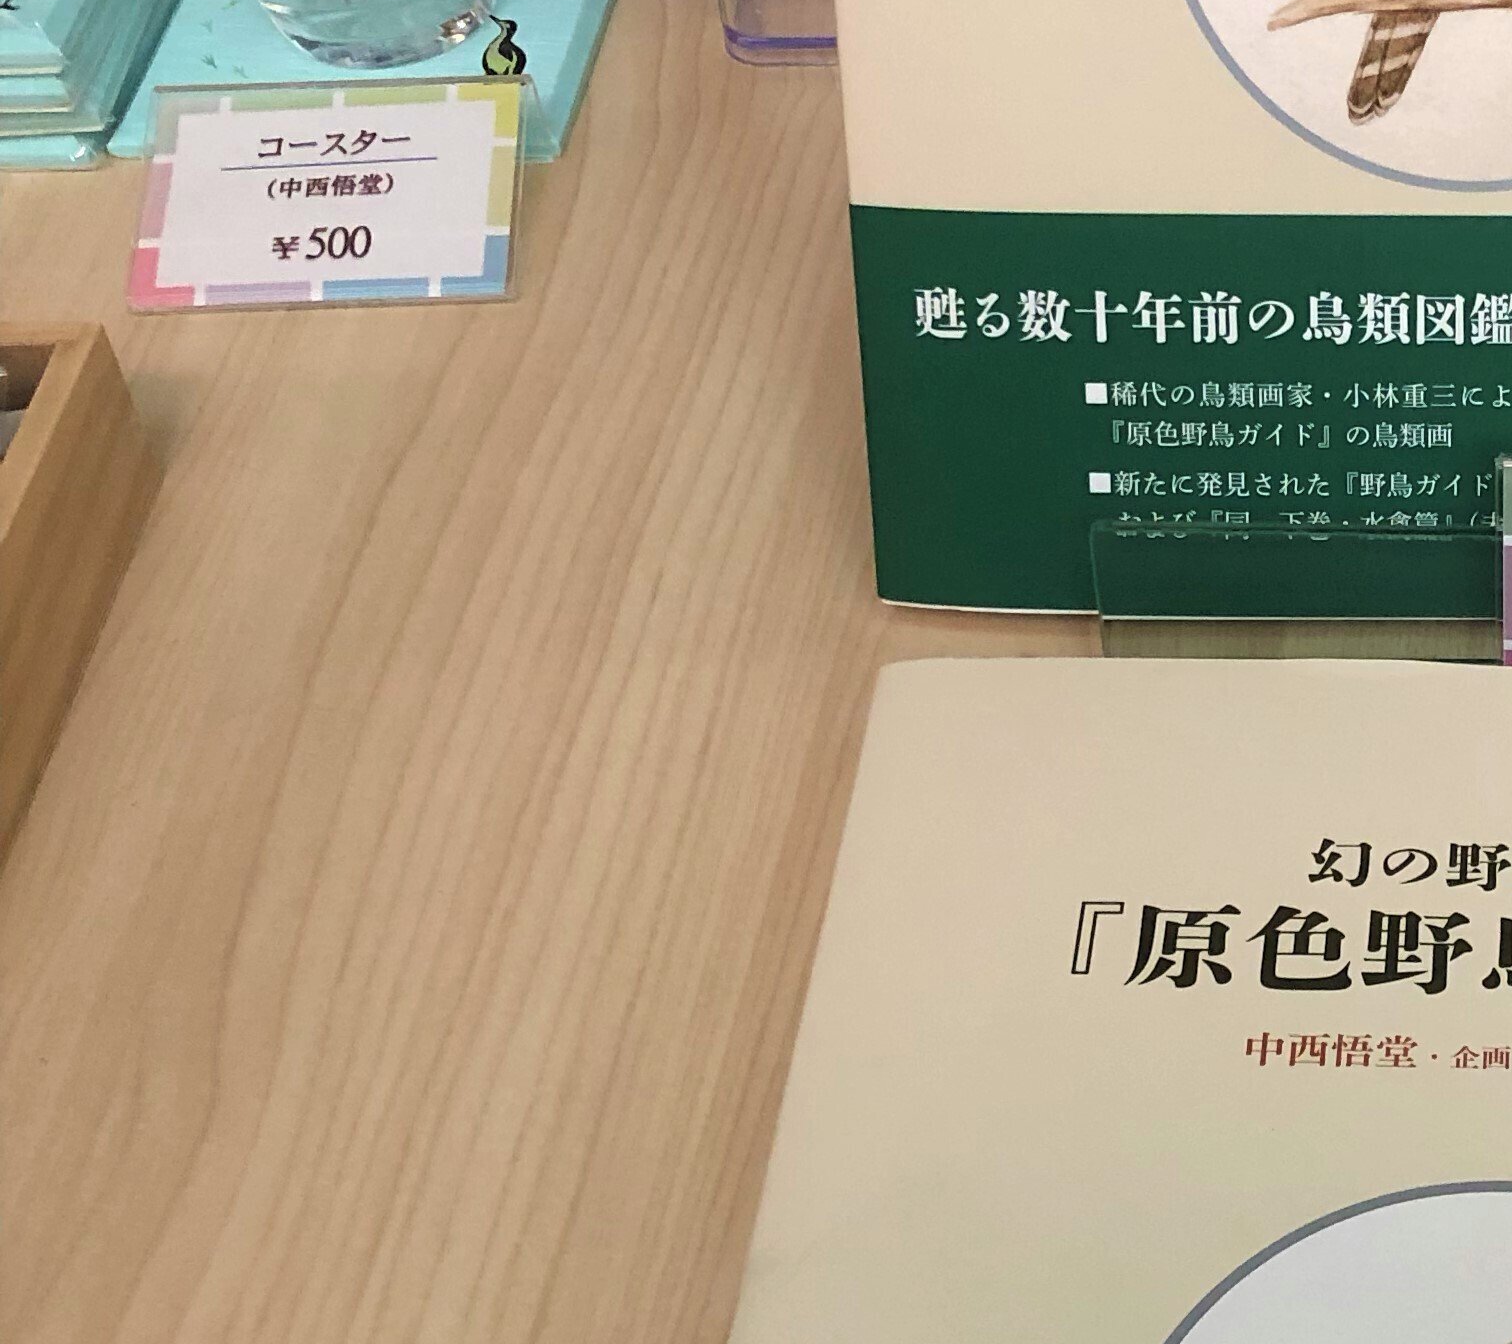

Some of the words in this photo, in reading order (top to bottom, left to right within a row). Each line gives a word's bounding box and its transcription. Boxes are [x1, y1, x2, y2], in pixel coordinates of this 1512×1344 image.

[256, 127, 413, 159] コースター
[271, 224, 373, 262] ¥500
[1111, 419, 1454, 450] 『原色野鳥ガイド』の鳥類画
[1244, 1030, 1512, 1071] 中西悟堂・企画
